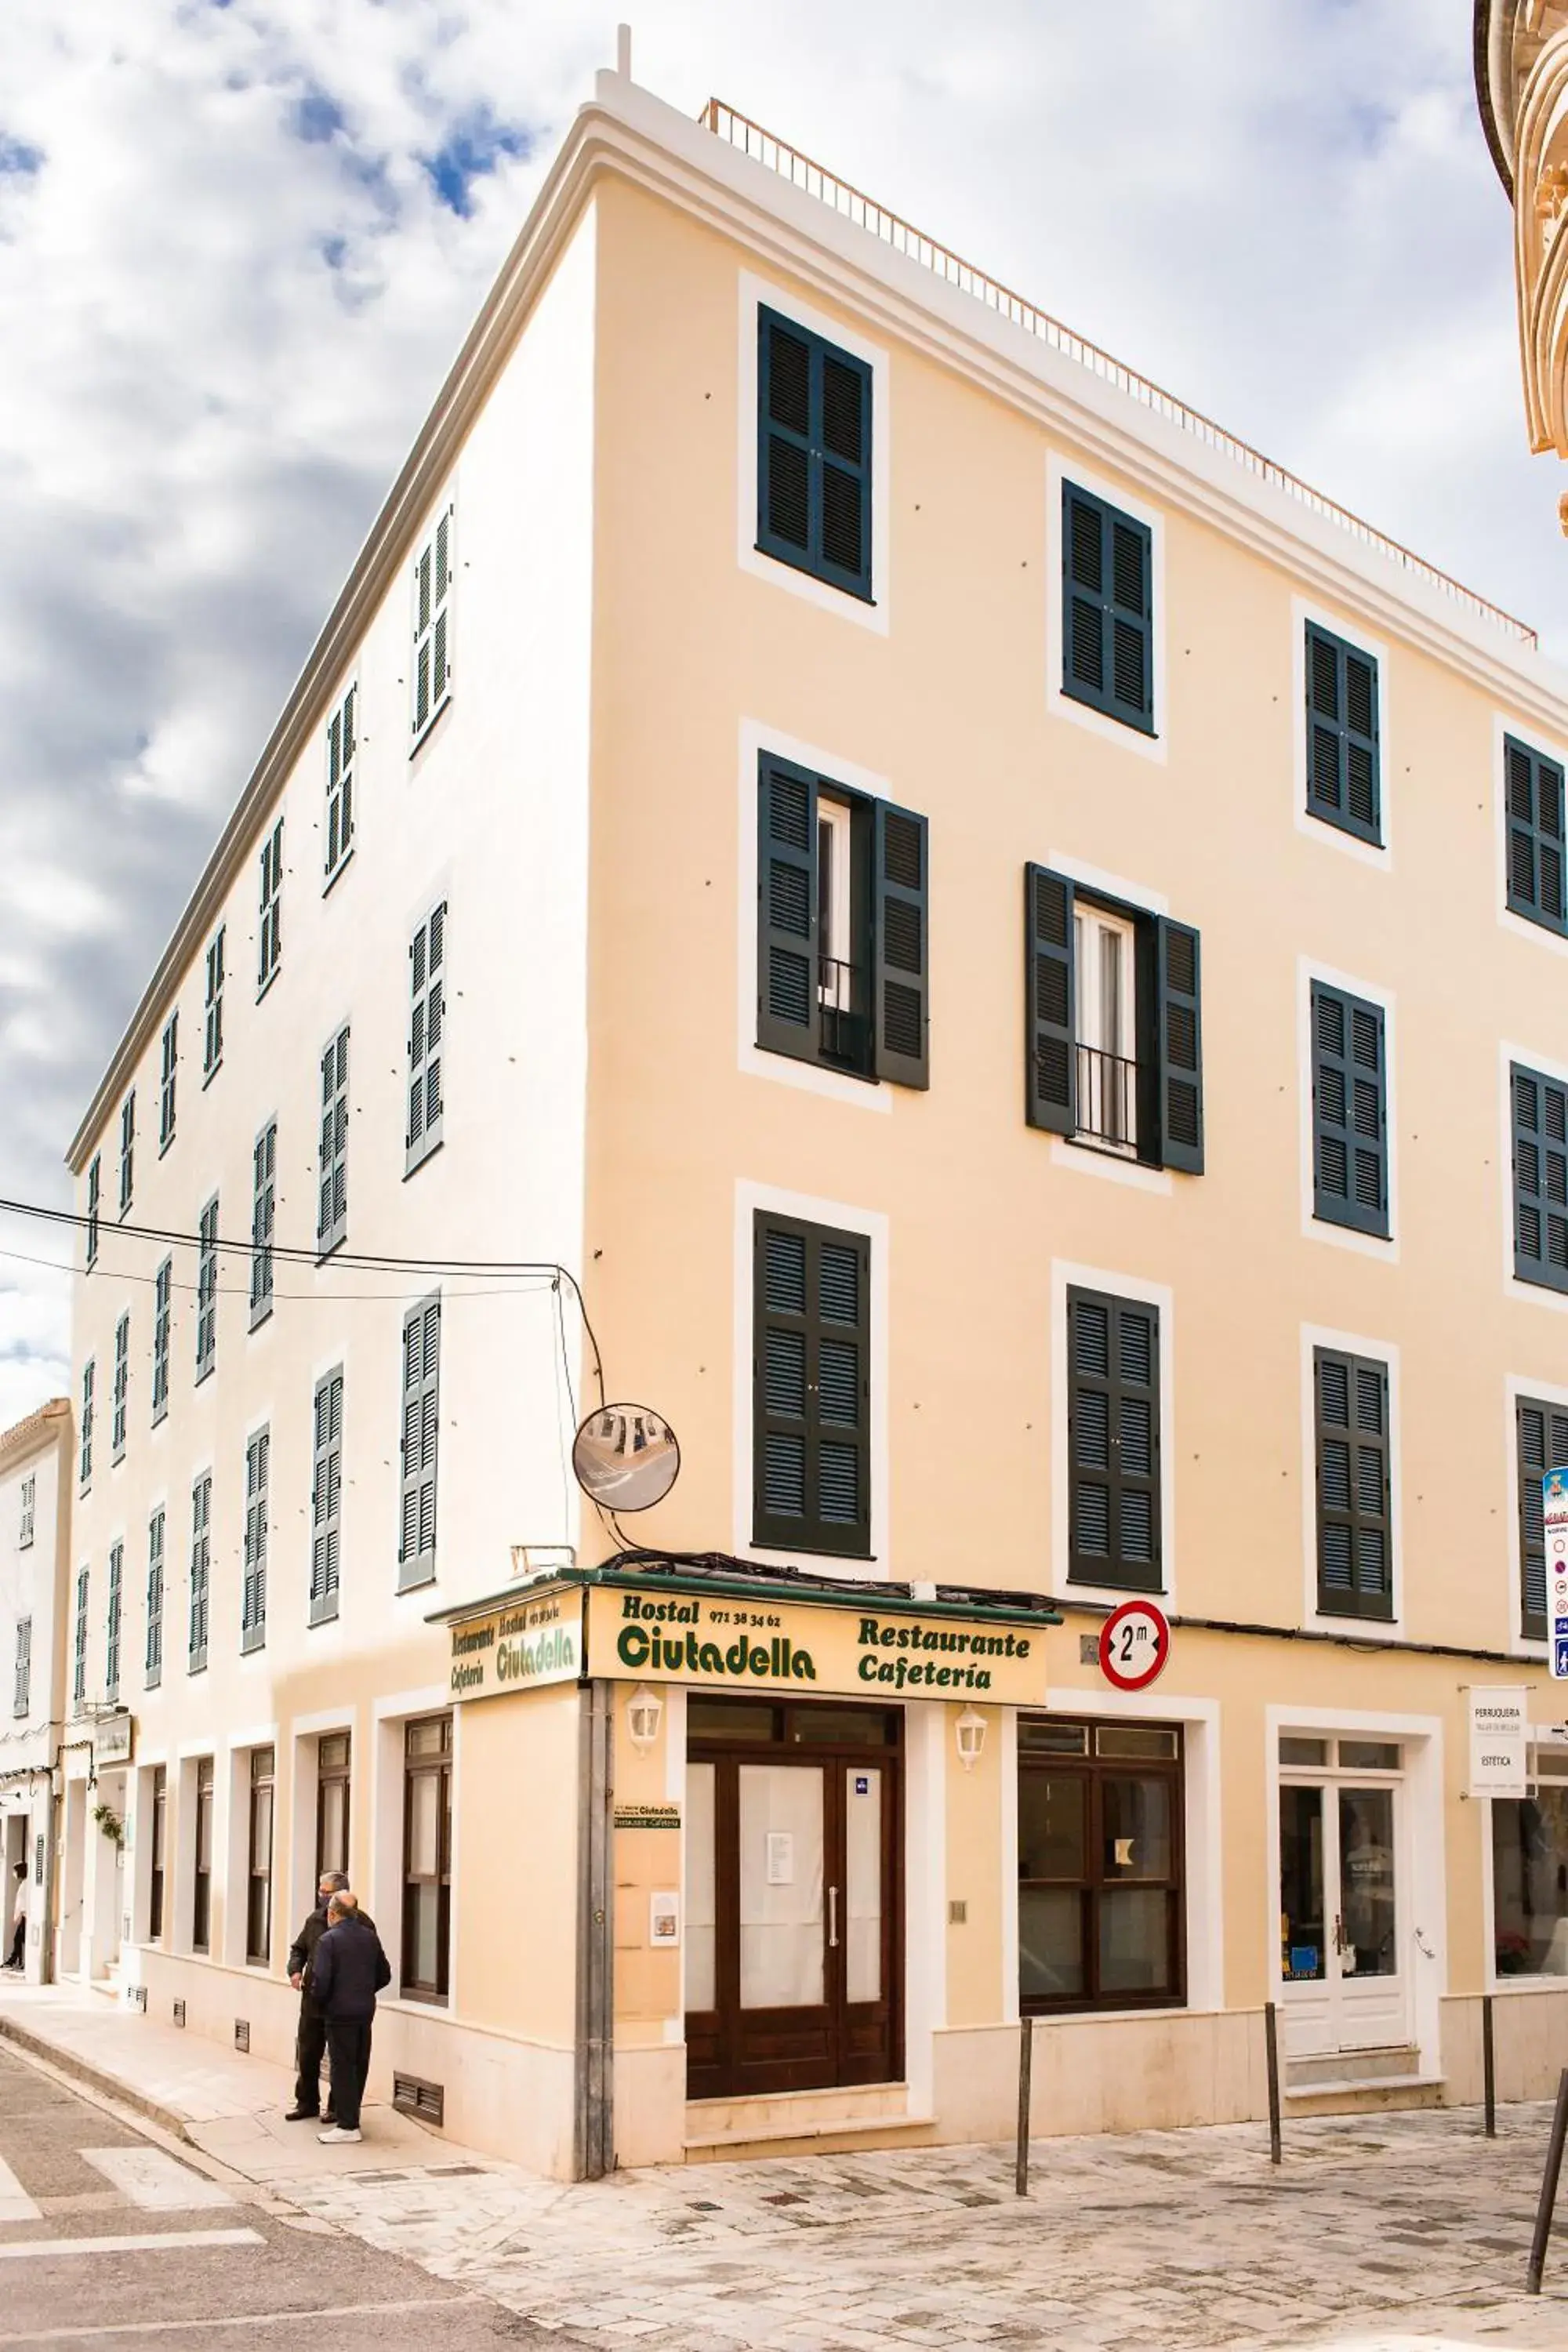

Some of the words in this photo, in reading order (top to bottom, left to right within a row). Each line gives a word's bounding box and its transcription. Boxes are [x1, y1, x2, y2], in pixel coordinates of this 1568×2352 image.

[622, 1595, 699, 1624] Hostal
[710, 1611, 730, 1623] 971
[734, 1613, 746, 1625] 38
[750, 1614, 764, 1628] 34
[767, 1614, 781, 1628] 62
[496, 1628, 574, 1681] Ciutadella
[617, 1624, 816, 1680] Ciutadella
[858, 1618, 1030, 1658] Restaurante
[858, 1654, 992, 1689] Cafetería
